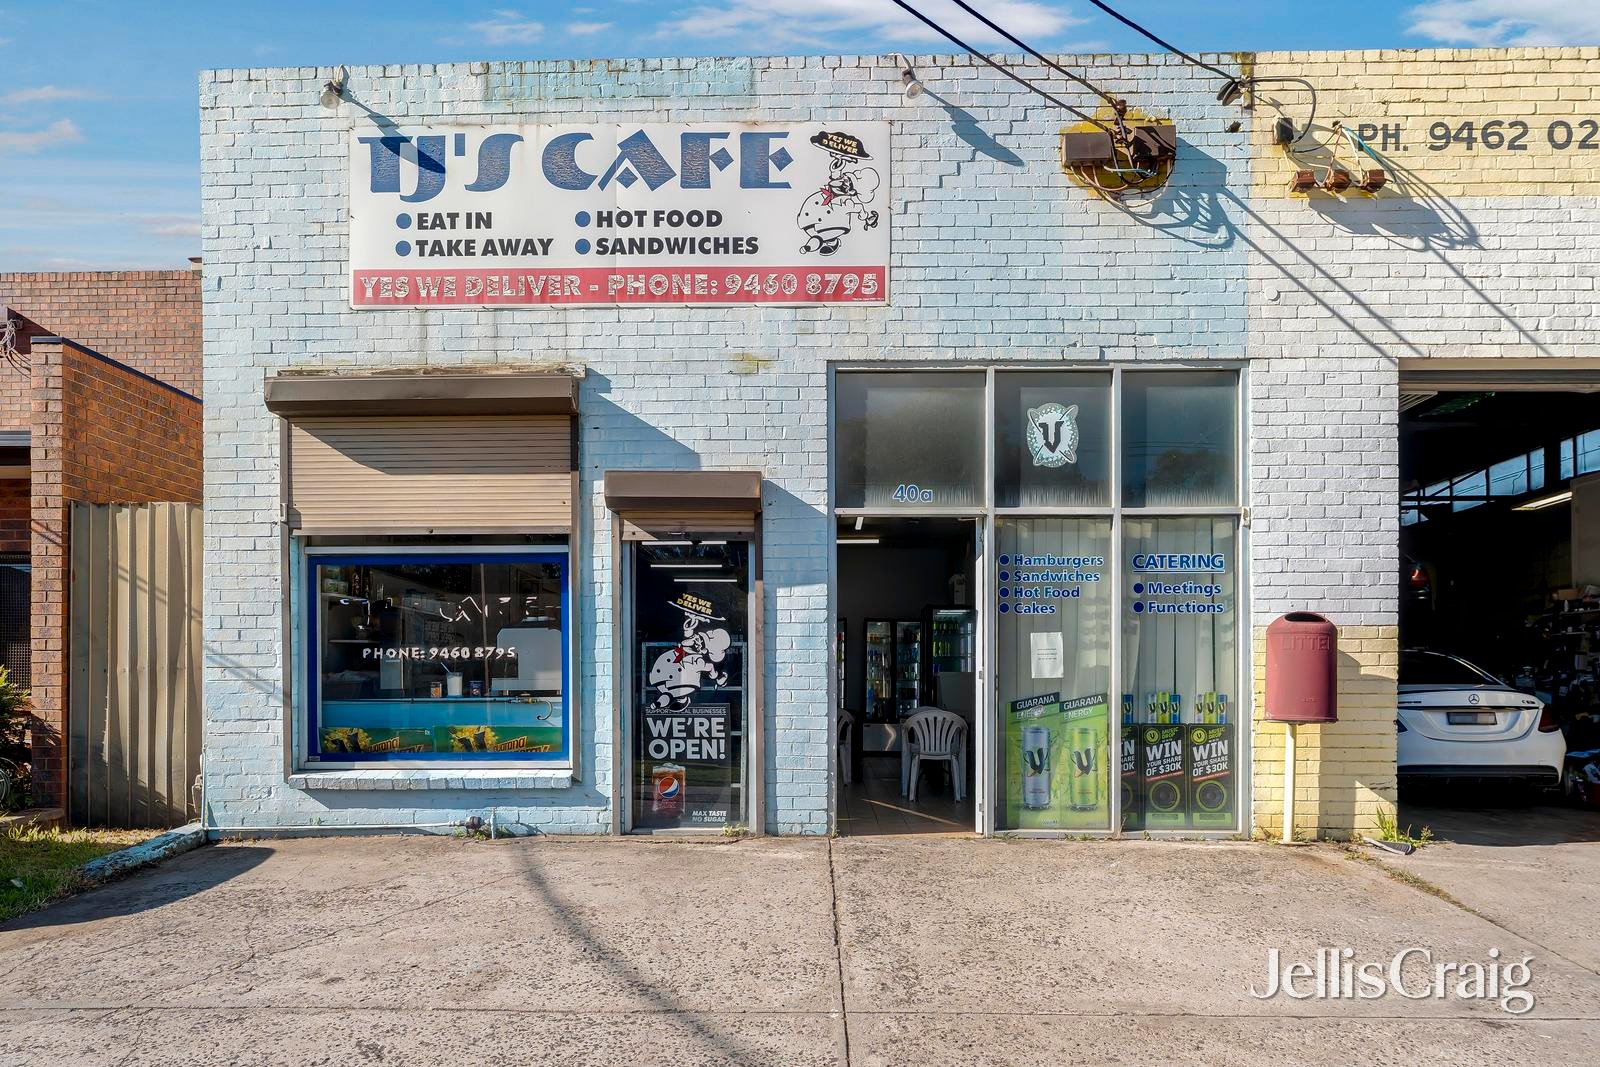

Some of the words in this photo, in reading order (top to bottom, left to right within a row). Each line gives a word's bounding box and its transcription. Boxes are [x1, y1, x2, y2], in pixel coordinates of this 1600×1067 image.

[827, 133, 842, 143] YES
[843, 138, 858, 148] WE
[1357, 123, 1408, 151] PH.
[1427, 120, 1529, 151] 9462
[1547, 120, 1600, 151] 02
[822, 139, 859, 155] DELIVER
[541, 129, 795, 192] CAFE
[416, 212, 463, 230] EAT
[465, 211, 493, 230] IN
[596, 211, 650, 229] HOT
[653, 210, 723, 228] FOOD
[416, 239, 477, 257] TAKE
[481, 238, 554, 257] AWAY
[595, 237, 760, 256] SANDWICHES
[360, 276, 410, 298] YES
[415, 276, 457, 297] WE
[465, 275, 582, 297] DELIVER
[608, 274, 718, 296] PHONE:
[725, 273, 798, 295] 9460
[805, 273, 879, 295] 8795
[892, 484, 934, 503] 40a
[1013, 553, 1104, 568] Hamburgers
[1131, 553, 1225, 570] CATERING
[1013, 569, 1101, 583] Sandwiches
[1013, 586, 1041, 599] Hot
[1043, 586, 1081, 599] Food
[1147, 581, 1222, 598] Meetings
[676, 598, 713, 615] DELIVER
[682, 592, 697, 603] YES
[698, 598, 712, 608] WE
[1147, 600, 1225, 614] Functions
[1013, 602, 1057, 615] Cakes
[362, 647, 425, 660] PHONE:
[429, 646, 471, 660] 9460
[475, 646, 517, 660] 8795
[1016, 695, 1056, 710] GUARANA
[1063, 695, 1103, 710] GUARANA
[1063, 706, 1094, 720] ENERGY
[646, 717, 726, 738] WE'RE
[648, 738, 726, 760] OPEN!
[1145, 739, 1182, 762] WIN
[1192, 739, 1229, 762] WIN
[1145, 767, 1158, 777] OF
[1159, 761, 1182, 775] $30K
[1146, 759, 1162, 768] YOUR
[1162, 755, 1182, 766] SHARE
[1192, 767, 1205, 777] OF
[1205, 761, 1229, 775] $30K
[1193, 759, 1209, 768] YOUR
[1209, 755, 1229, 766] SHARE
